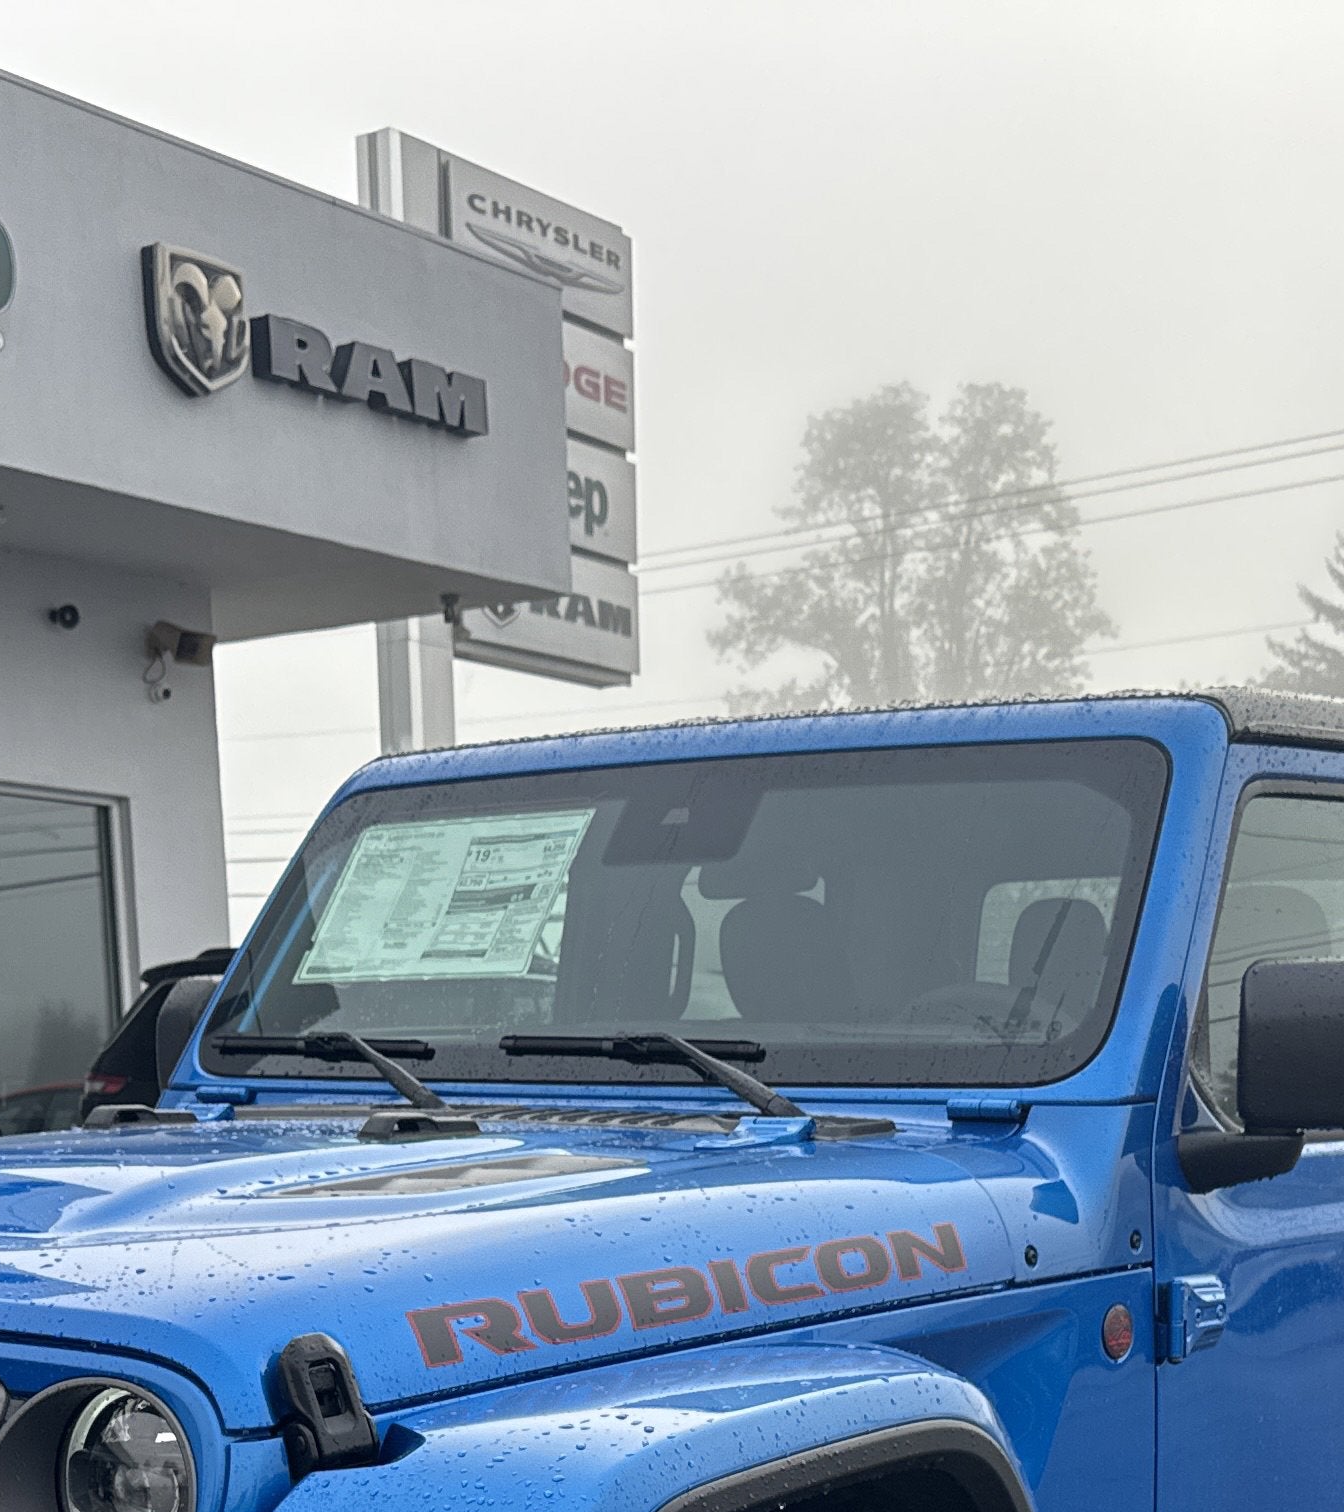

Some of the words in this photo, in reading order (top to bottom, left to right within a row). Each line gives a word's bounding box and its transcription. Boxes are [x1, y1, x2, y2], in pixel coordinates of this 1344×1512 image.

[466, 193, 622, 271] CHRYSLER
[250, 313, 489, 438] RAM
[406, 1222, 968, 1369] RUBICON
